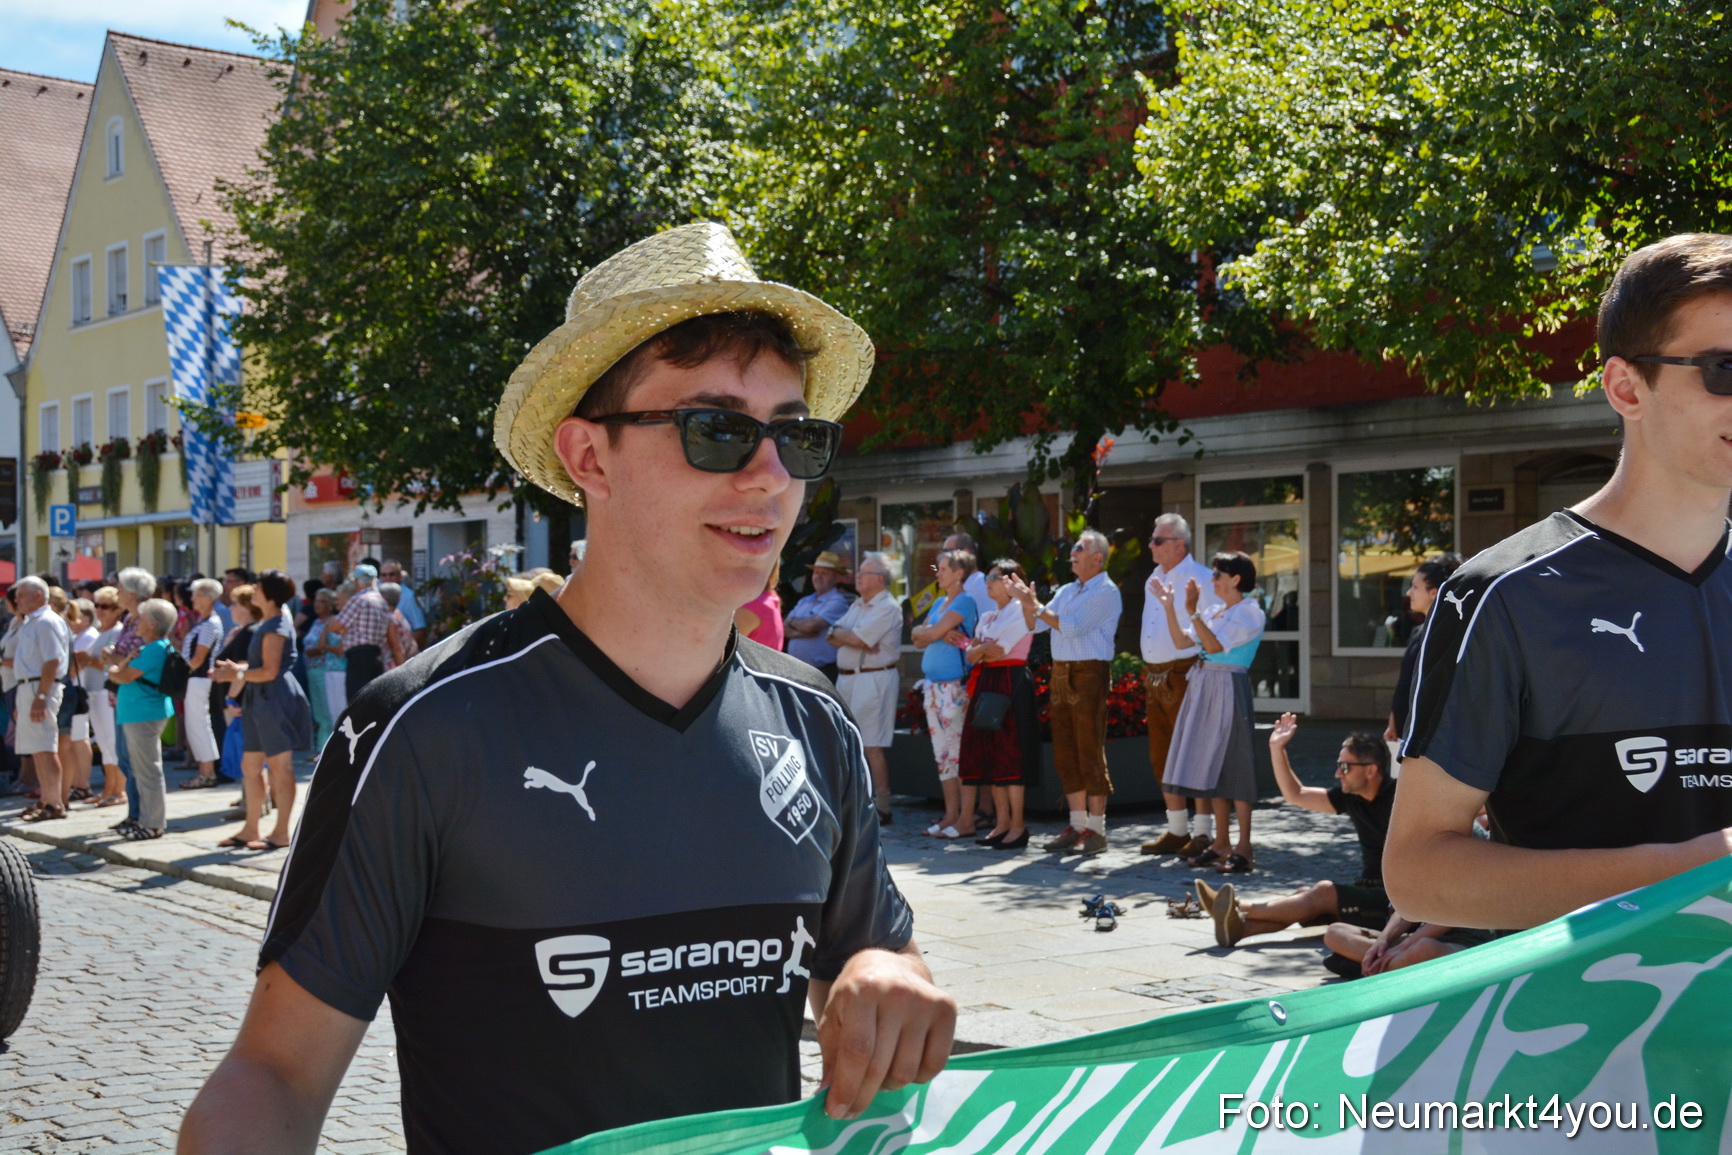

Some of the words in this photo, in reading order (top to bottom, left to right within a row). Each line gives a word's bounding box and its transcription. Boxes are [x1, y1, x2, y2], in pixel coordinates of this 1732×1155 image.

[55, 508, 70, 534] P
[755, 736, 779, 759] SV
[1674, 747, 1732, 766] sara
[765, 755, 802, 804] PÖLLING
[786, 792, 813, 828] 1950
[621, 938, 782, 977] sarango
[628, 975, 774, 1010] TEAMSPORT
